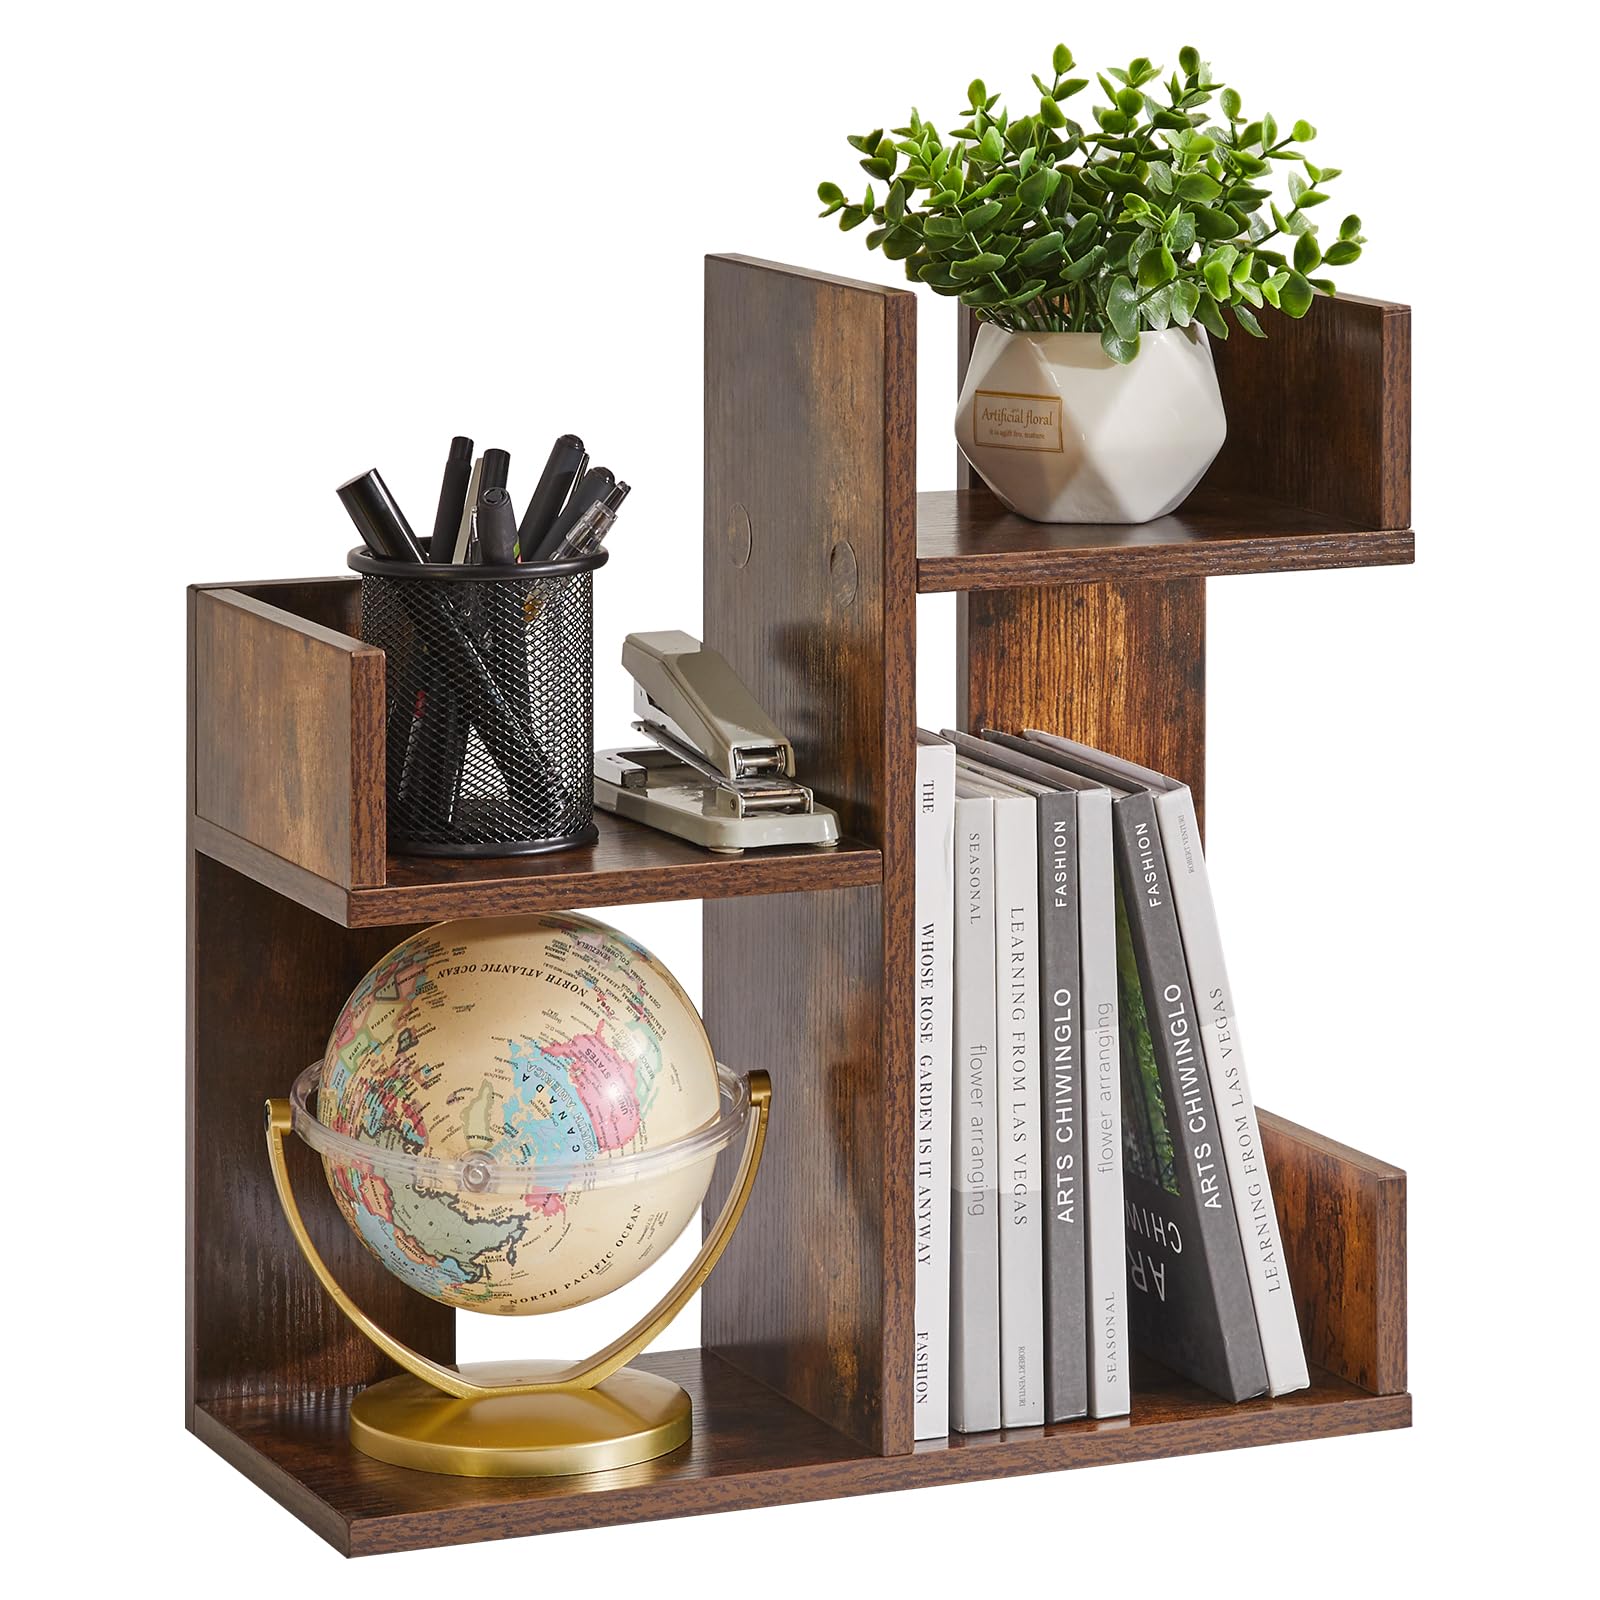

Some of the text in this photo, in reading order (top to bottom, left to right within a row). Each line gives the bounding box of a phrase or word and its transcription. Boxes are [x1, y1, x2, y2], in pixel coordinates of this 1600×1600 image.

[982, 407, 1053, 428] Artificial floral
[922, 779, 934, 815] THE
[969, 832, 982, 925] SEASONAL
[1054, 820, 1068, 908] FASHION
[1135, 822, 1161, 907] FASHION
[437, 963, 588, 998] NORTH ATLANTIC OCEAN
[576, 940, 611, 962] VENEZUELA
[370, 1008, 396, 1030] ALGERIA
[526, 1061, 576, 1111] AMERICA
[585, 1048, 612, 1080] STATES
[918, 922, 934, 1266] WHOSE ROSE GARDEN IS IT ANYWAY
[1011, 907, 1028, 1226] LEARNING FROM LAS VEGAS
[1053, 988, 1074, 1224] ARTS CHIWINGLO
[1095, 1001, 1115, 1175] flower arranging
[1164, 984, 1222, 1209] ARTS CHIWINGLO
[522, 1072, 580, 1152] CANADA
[574, 1112, 596, 1161] NORTH
[967, 1044, 989, 1217] flower arranging
[1209, 988, 1281, 1293] LEARNING FROM LAS VEGAS
[396, 1235, 425, 1262] MONGOLIA
[510, 1204, 642, 1306] NORTH PACIFIC OCEAN
[917, 1331, 929, 1405] FASHION
[1104, 1291, 1117, 1384] SEASONAL
